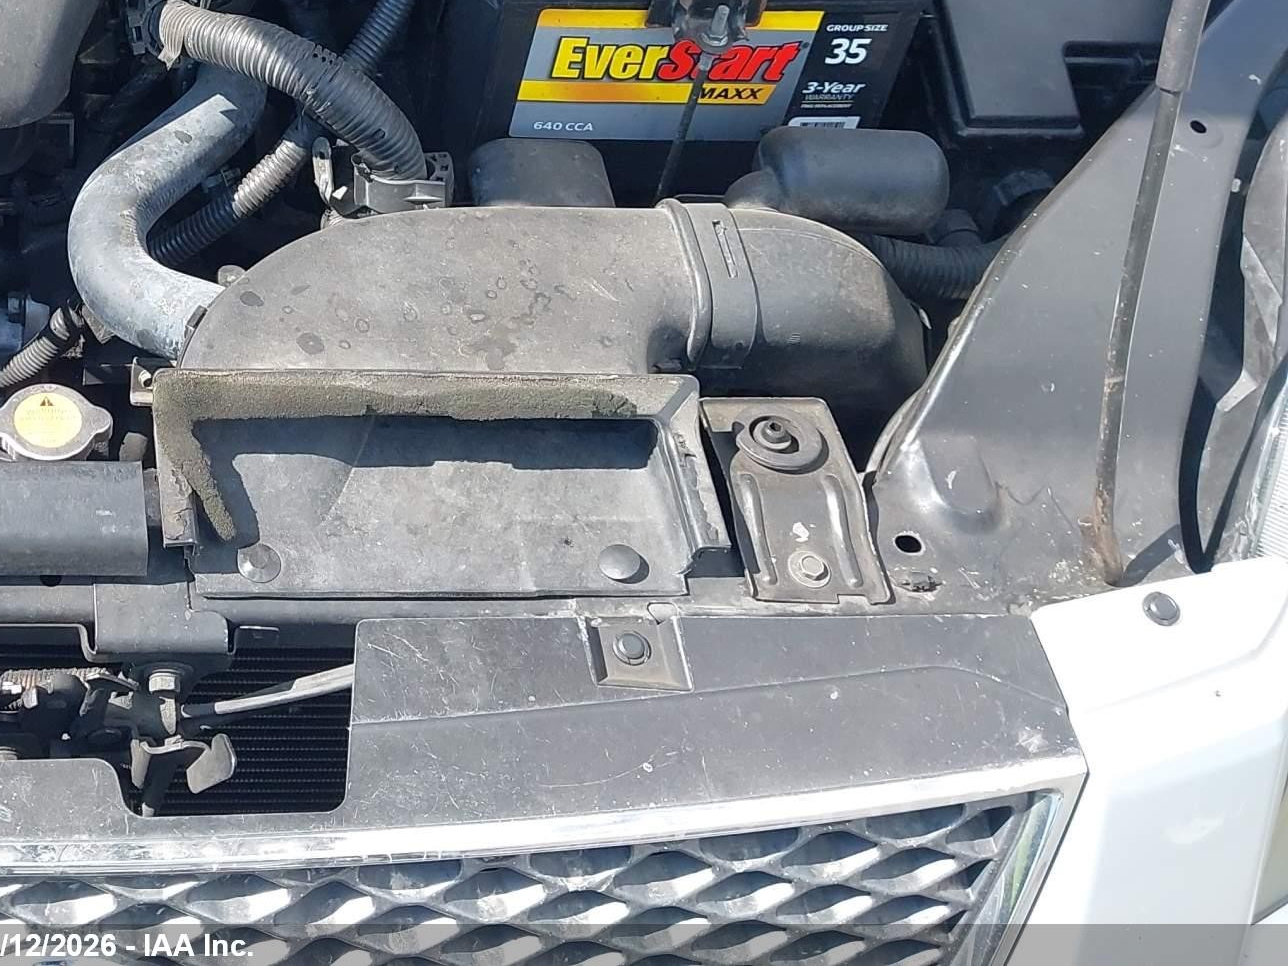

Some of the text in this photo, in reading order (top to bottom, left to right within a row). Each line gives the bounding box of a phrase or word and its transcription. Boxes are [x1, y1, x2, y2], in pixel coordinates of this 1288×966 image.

[826, 24, 889, 32] GROUP SIZE
[824, 37, 873, 65] 35
[550, 35, 803, 83] EverSart
[698, 87, 763, 101] MAXX
[801, 81, 867, 94] 3-Year
[533, 121, 594, 132] 640 CCA
